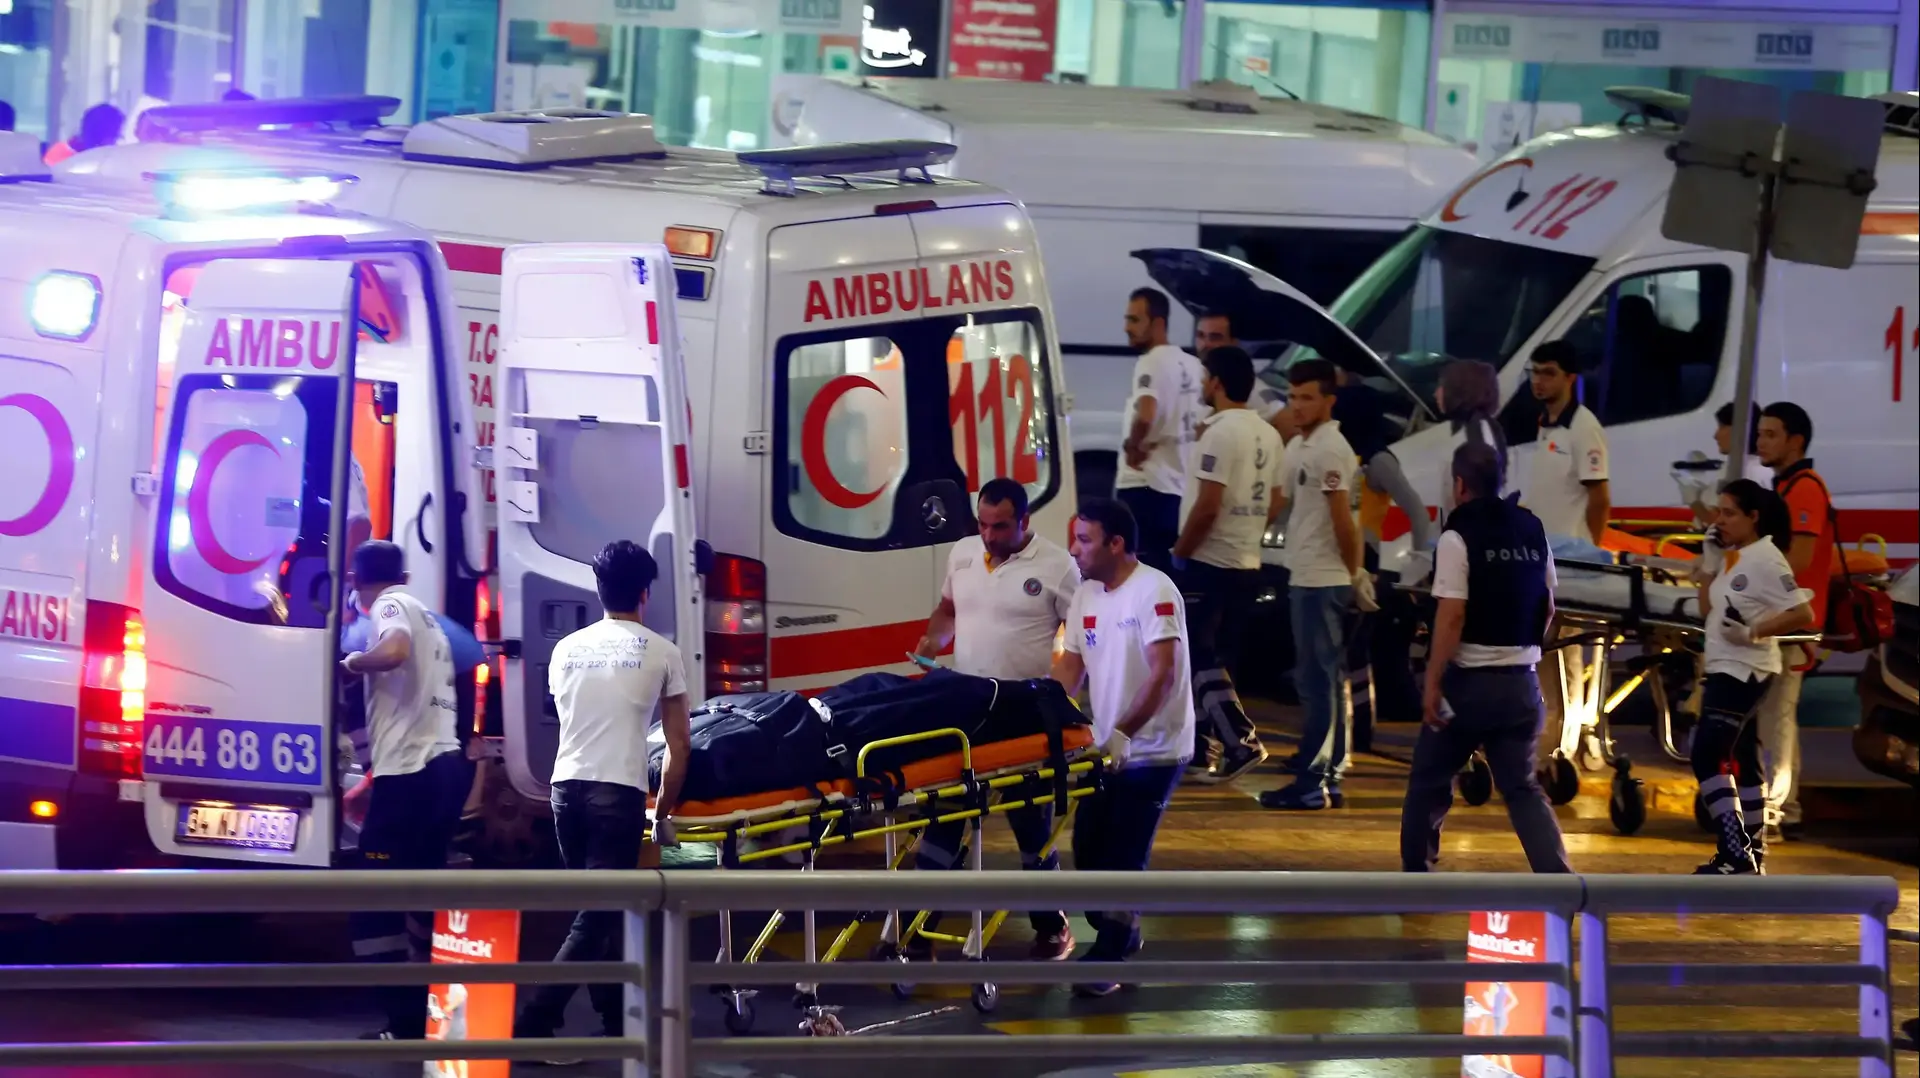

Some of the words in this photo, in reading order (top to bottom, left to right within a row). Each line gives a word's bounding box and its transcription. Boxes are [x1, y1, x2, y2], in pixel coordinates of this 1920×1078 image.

[1511, 172, 1618, 241] 112
[803, 259, 1015, 323] AMBULANS
[204, 318, 340, 370] AMBU
[949, 354, 1038, 493] 112
[1485, 546, 1540, 561] POLİS
[0, 590, 67, 642] ANSI
[145, 724, 207, 767] 444
[217, 729, 260, 771] 88
[271, 732, 317, 775] 63
